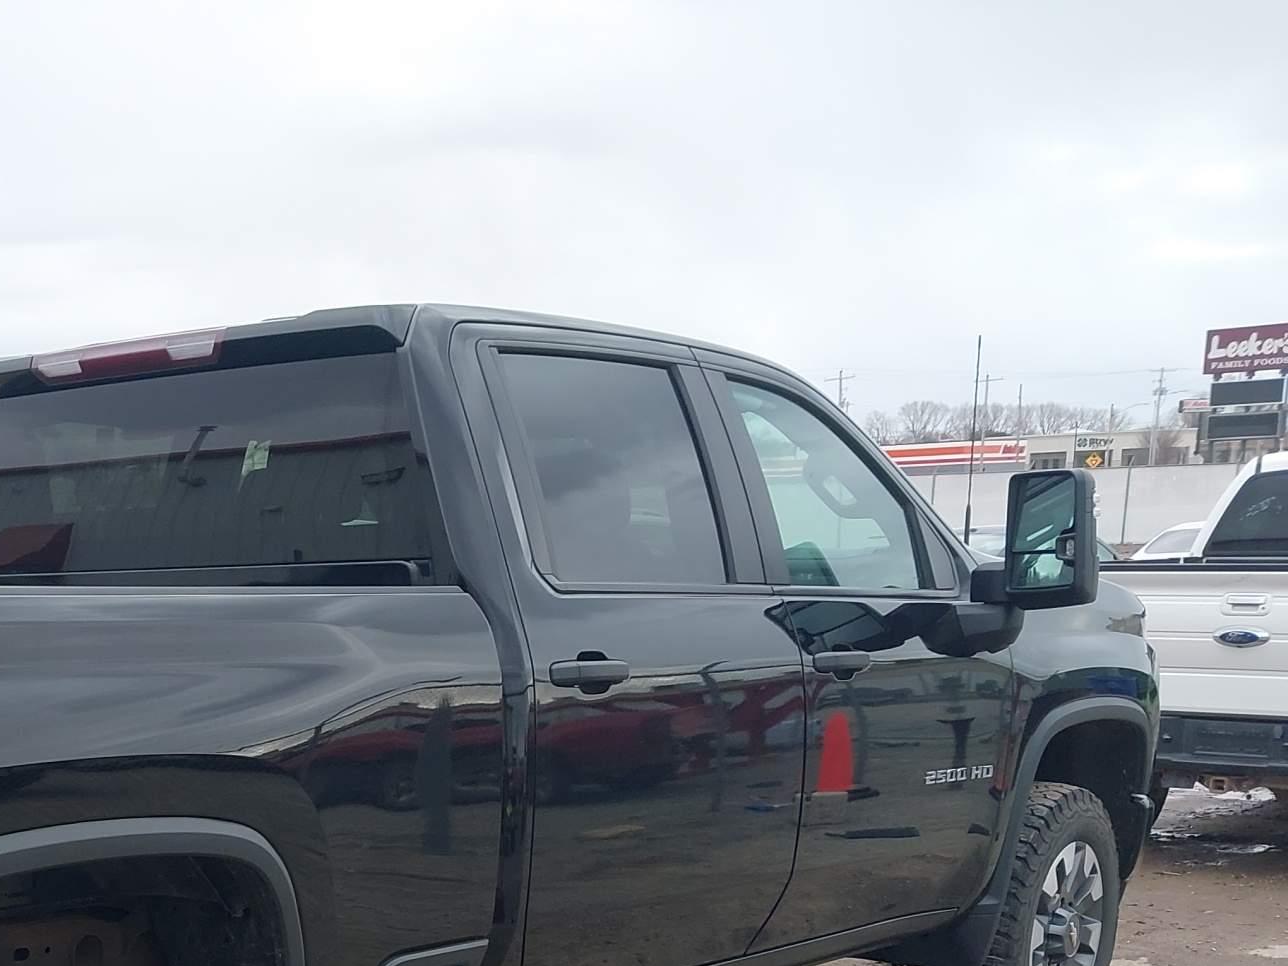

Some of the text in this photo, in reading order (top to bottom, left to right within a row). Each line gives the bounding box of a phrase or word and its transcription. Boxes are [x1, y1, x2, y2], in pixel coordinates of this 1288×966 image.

[1210, 359, 1252, 369] FAMILY
[924, 765, 994, 784] 2500 HD
